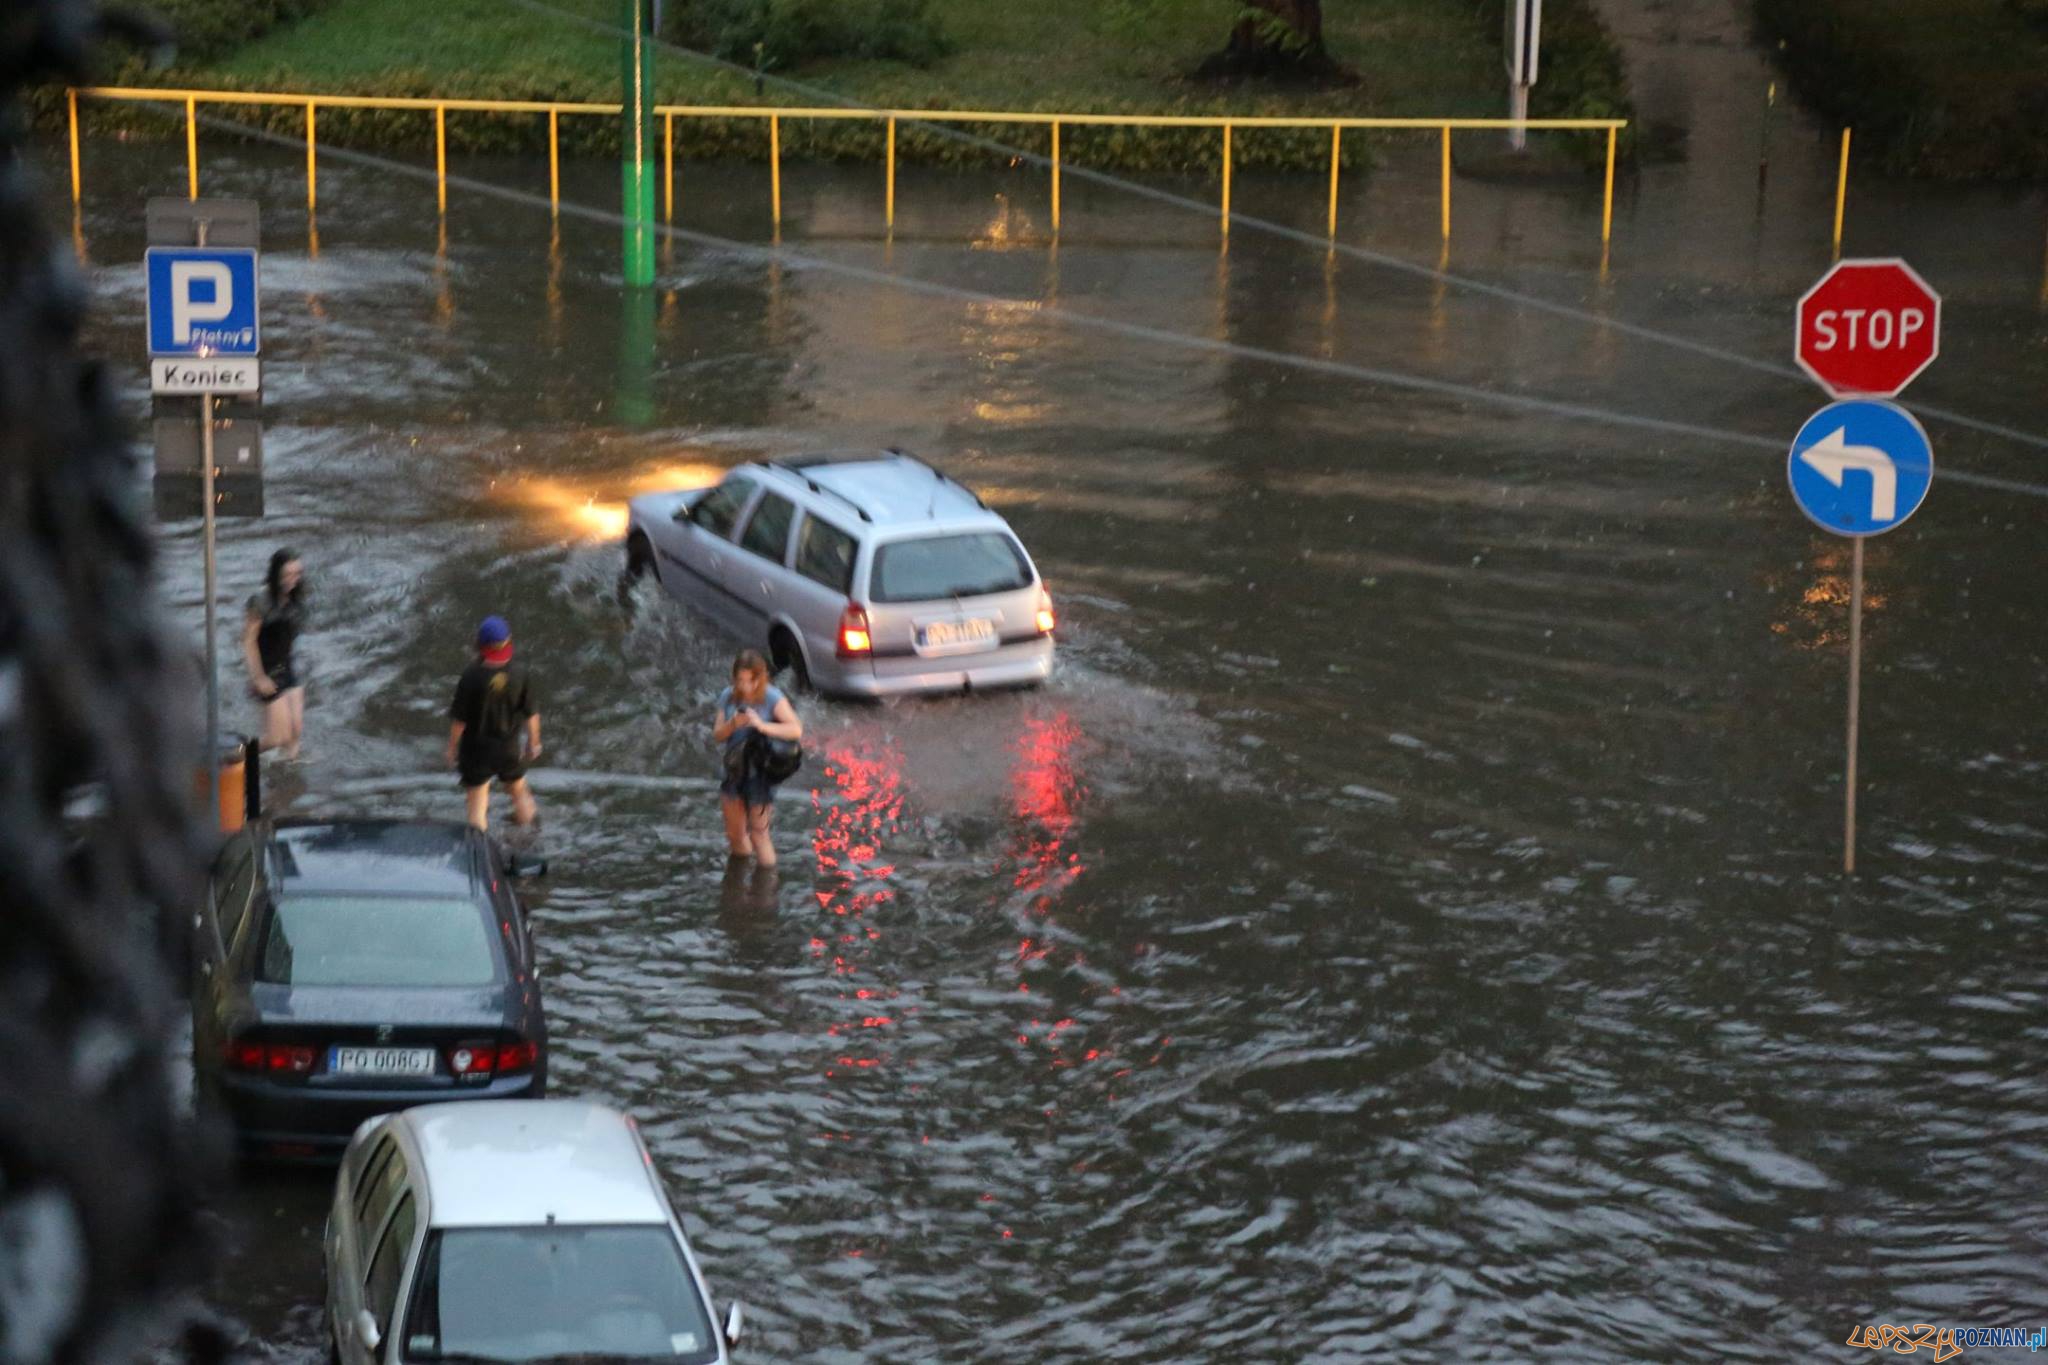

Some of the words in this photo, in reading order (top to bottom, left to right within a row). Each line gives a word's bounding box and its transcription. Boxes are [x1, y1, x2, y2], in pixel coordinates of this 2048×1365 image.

[171, 261, 232, 345] P
[1814, 307, 1924, 351] STOP
[164, 364, 246, 386] Koniec
